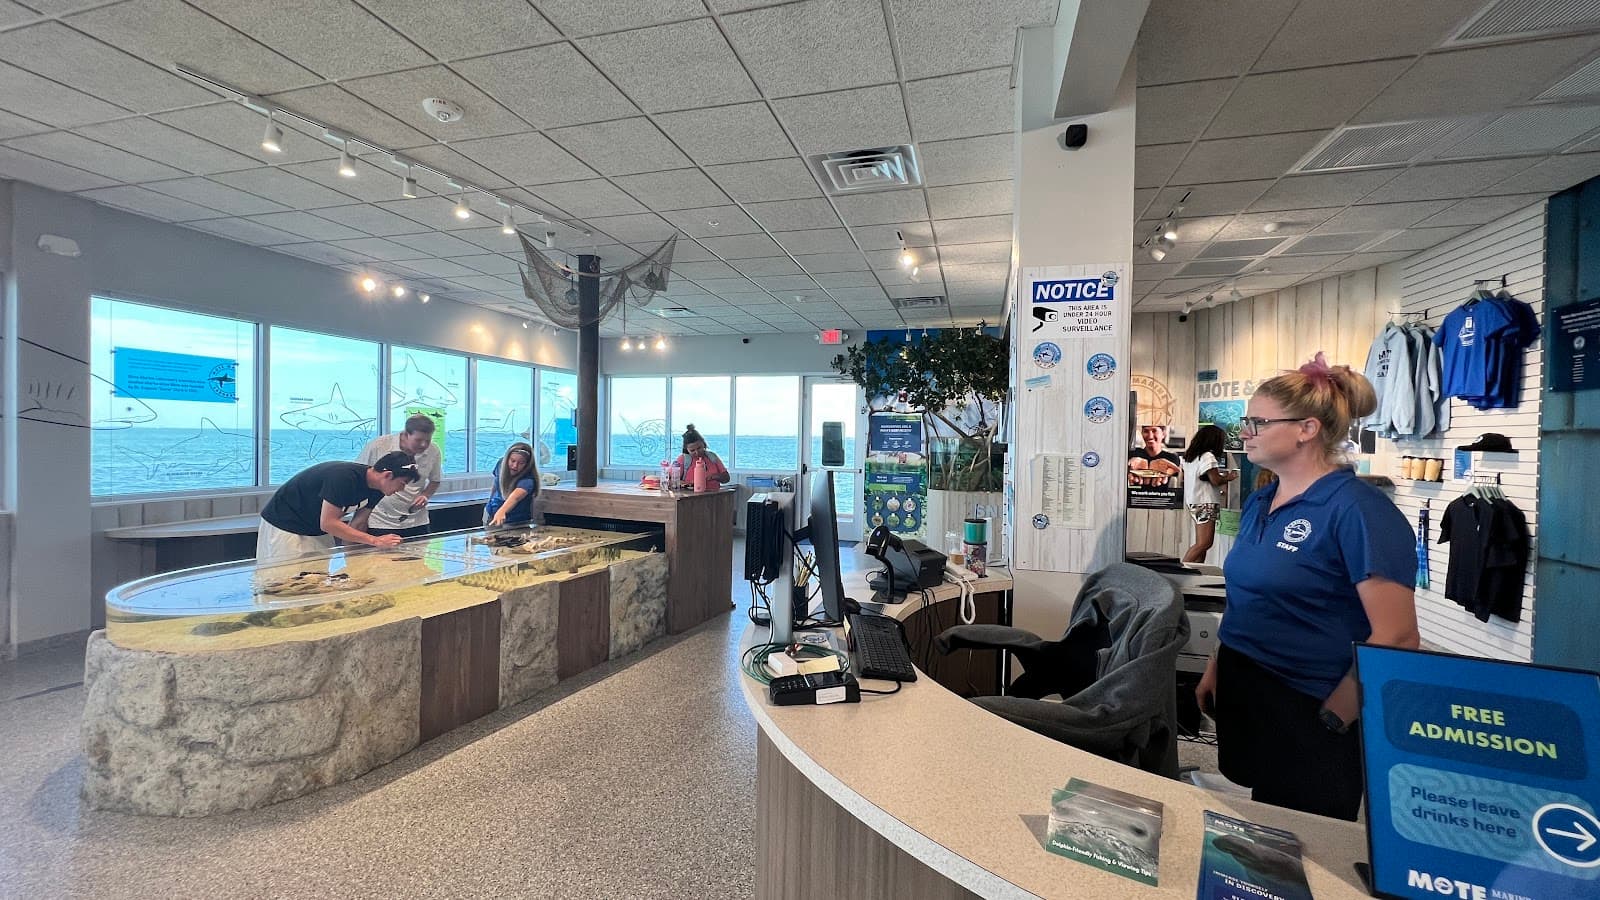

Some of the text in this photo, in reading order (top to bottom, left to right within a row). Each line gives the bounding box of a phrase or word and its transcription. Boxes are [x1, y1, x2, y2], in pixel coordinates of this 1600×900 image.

[1036, 282, 1109, 300] NOTICE
[1062, 324, 1113, 332] SURVEILLANCE
[1198, 380, 1254, 399] MOTE &
[1276, 541, 1299, 553] STAFF
[1451, 704, 1506, 726] FREE
[1408, 721, 1558, 760] ADMISSION
[1411, 786, 1521, 820] Please leave
[1412, 806, 1518, 839] drinks here
[1052, 840, 1093, 858] Dolphin-Friendly
[1093, 853, 1111, 865] Fishing
[1117, 860, 1139, 874] Viewing
[1140, 868, 1152, 877] Tips
[1224, 879, 1234, 887] IN
[1407, 869, 1487, 900] MOTE
